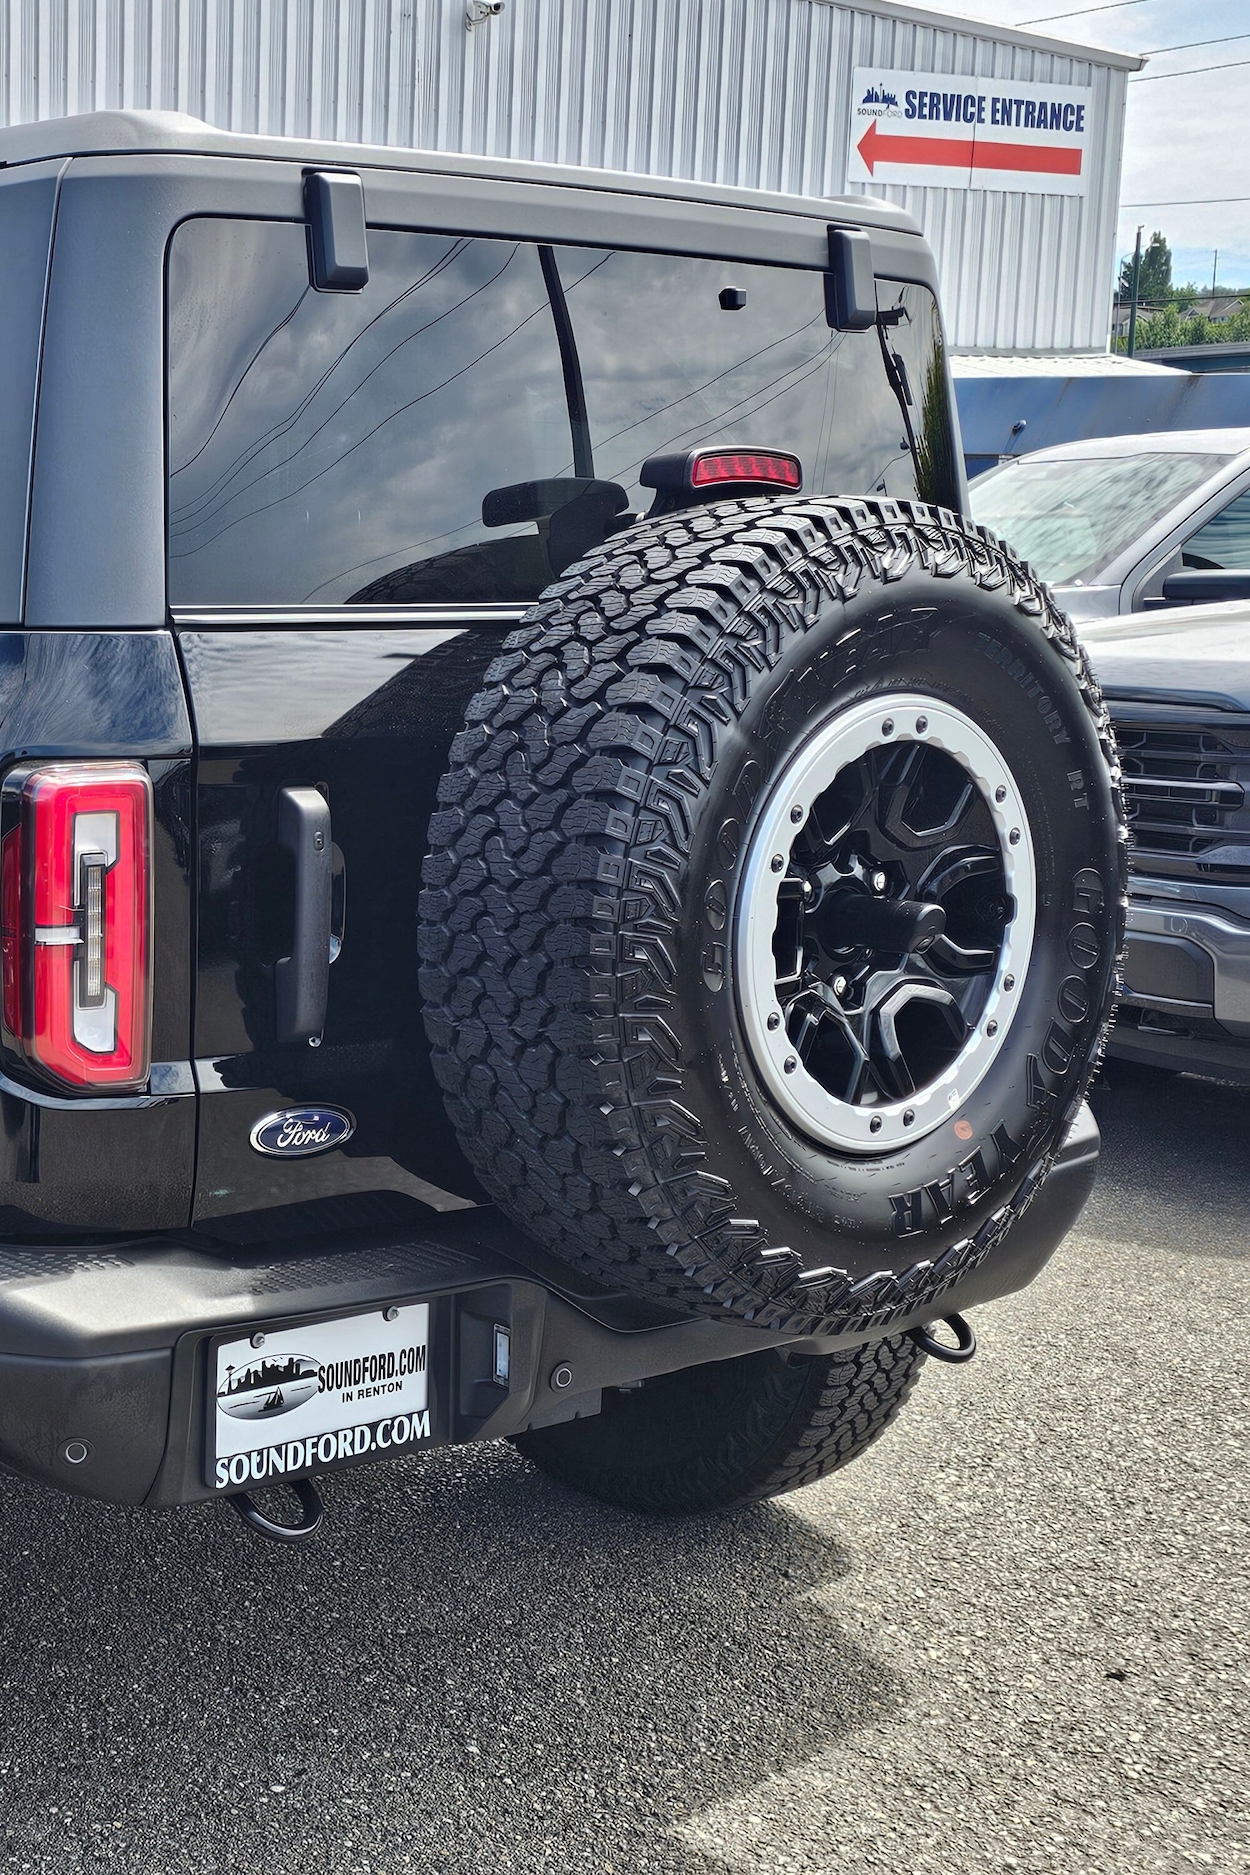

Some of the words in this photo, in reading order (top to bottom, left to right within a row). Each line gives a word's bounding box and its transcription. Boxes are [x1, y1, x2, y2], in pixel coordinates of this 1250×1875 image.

[905, 90, 985, 123] SERVICE
[991, 97, 1085, 132] ENTRANCE
[973, 632, 1071, 744] TERRITORY
[1067, 769, 1090, 810] RT
[277, 1114, 331, 1147] Ford
[317, 1344, 427, 1393] SOUNDFORD.COM
[341, 1392, 353, 1403] IN
[357, 1381, 403, 1400] RENTON
[215, 1410, 432, 1489] SOUNDFORD.COM
